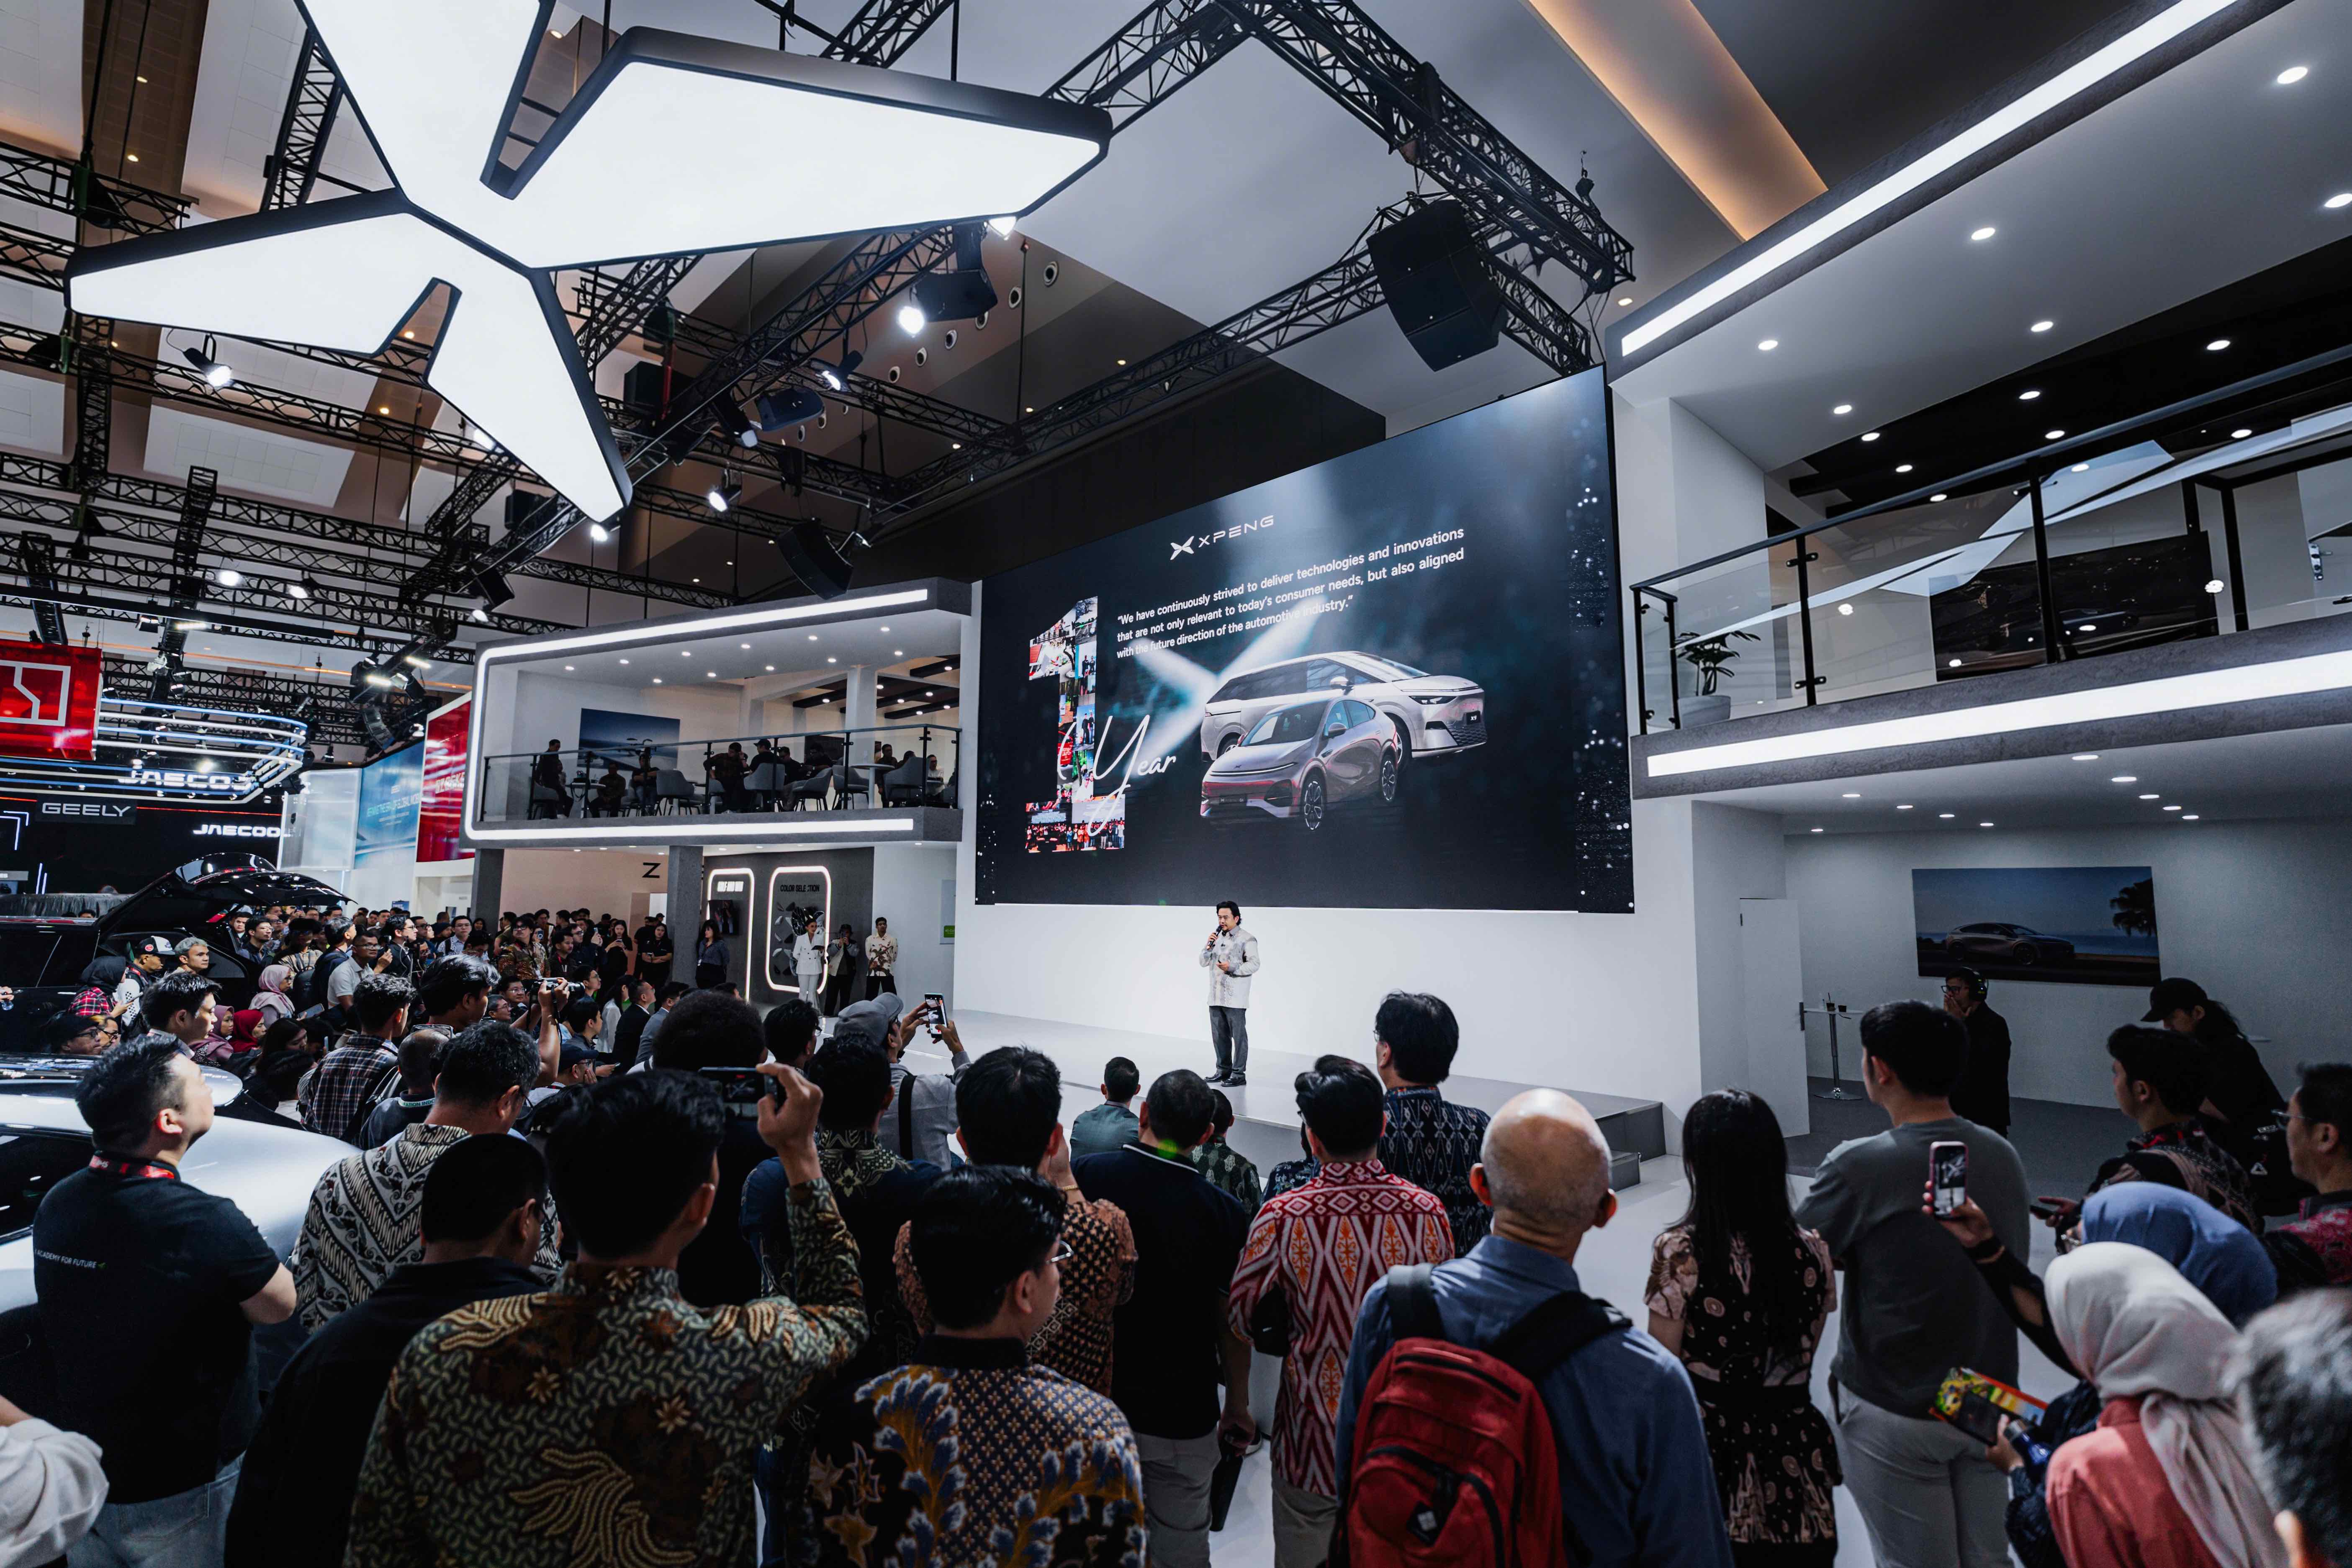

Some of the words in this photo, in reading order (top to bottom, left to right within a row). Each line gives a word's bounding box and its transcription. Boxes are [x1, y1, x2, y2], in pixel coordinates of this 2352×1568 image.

[1198, 515, 1274, 548] XPENG
[1136, 609, 1154, 623] have
[1157, 594, 1211, 616] continuously
[1213, 584, 1244, 601] strived
[1247, 581, 1257, 592] to
[1261, 571, 1293, 589] deliver
[1296, 554, 1365, 579] technologies
[1368, 545, 1389, 562] and
[1393, 527, 1464, 555] innovations
[1117, 631, 1133, 642] that
[1135, 629, 1148, 638] are
[1150, 624, 1164, 635] not
[1167, 617, 1185, 630] only
[1187, 609, 1222, 626] relevant
[1225, 606, 1235, 616] to
[1238, 596, 1272, 614] today's
[1275, 585, 1325, 604] consumer
[1328, 575, 1363, 591] needs,
[1368, 567, 1387, 583] but
[1391, 562, 1415, 577] also
[1419, 547, 1464, 570] aligned
[1117, 646, 1134, 658] with
[1135, 643, 1148, 654] the
[1150, 637, 1175, 651] future
[1177, 627, 1215, 646] direction
[1216, 625, 1226, 636] of
[1228, 622, 1243, 634] the
[1245, 609, 1300, 630] automotive
[42, 802, 131, 817] GEELY
[193, 824, 281, 838] JAECOO
[73, 1259, 98, 1268] FUTURE
